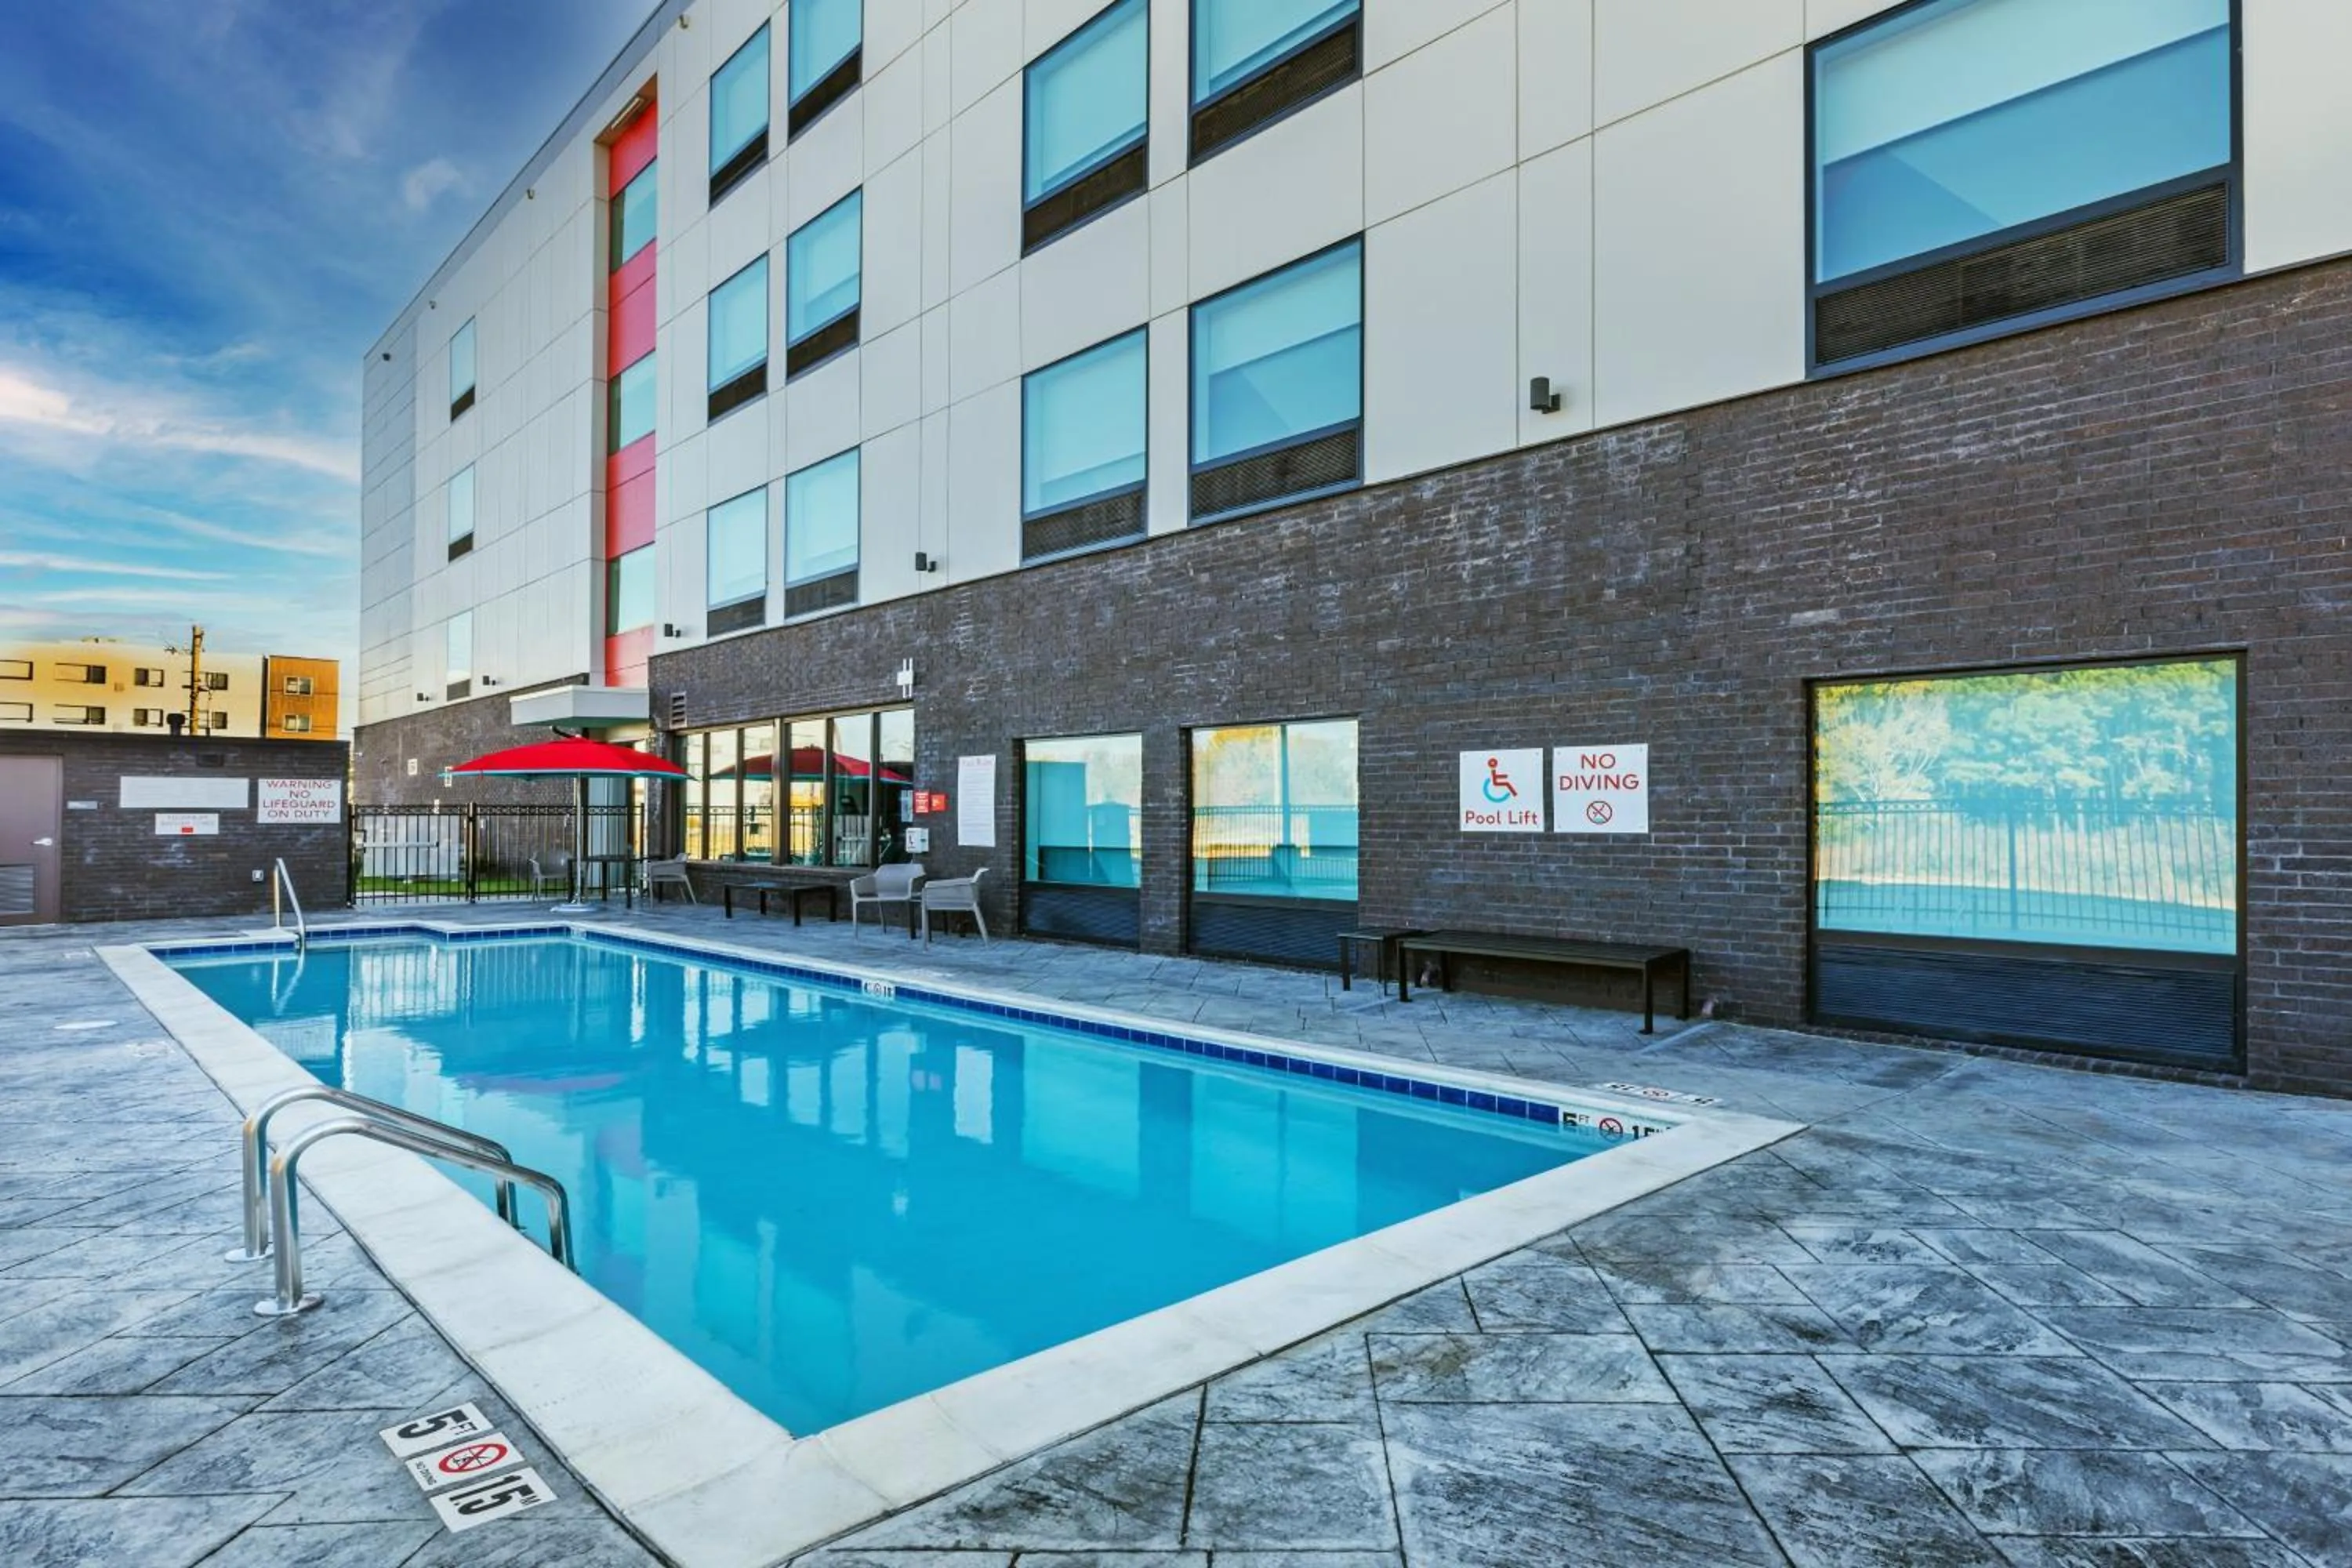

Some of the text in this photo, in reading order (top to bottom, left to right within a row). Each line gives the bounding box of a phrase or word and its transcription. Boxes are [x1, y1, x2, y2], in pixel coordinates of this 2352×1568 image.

[1581, 753, 1616, 769] NO
[267, 780, 332, 789] WARNING
[1559, 773, 1639, 791] DIVING
[289, 790, 311, 799] NO
[263, 800, 336, 808] LIFEGUARD
[1465, 809, 1537, 825] Pool Lift
